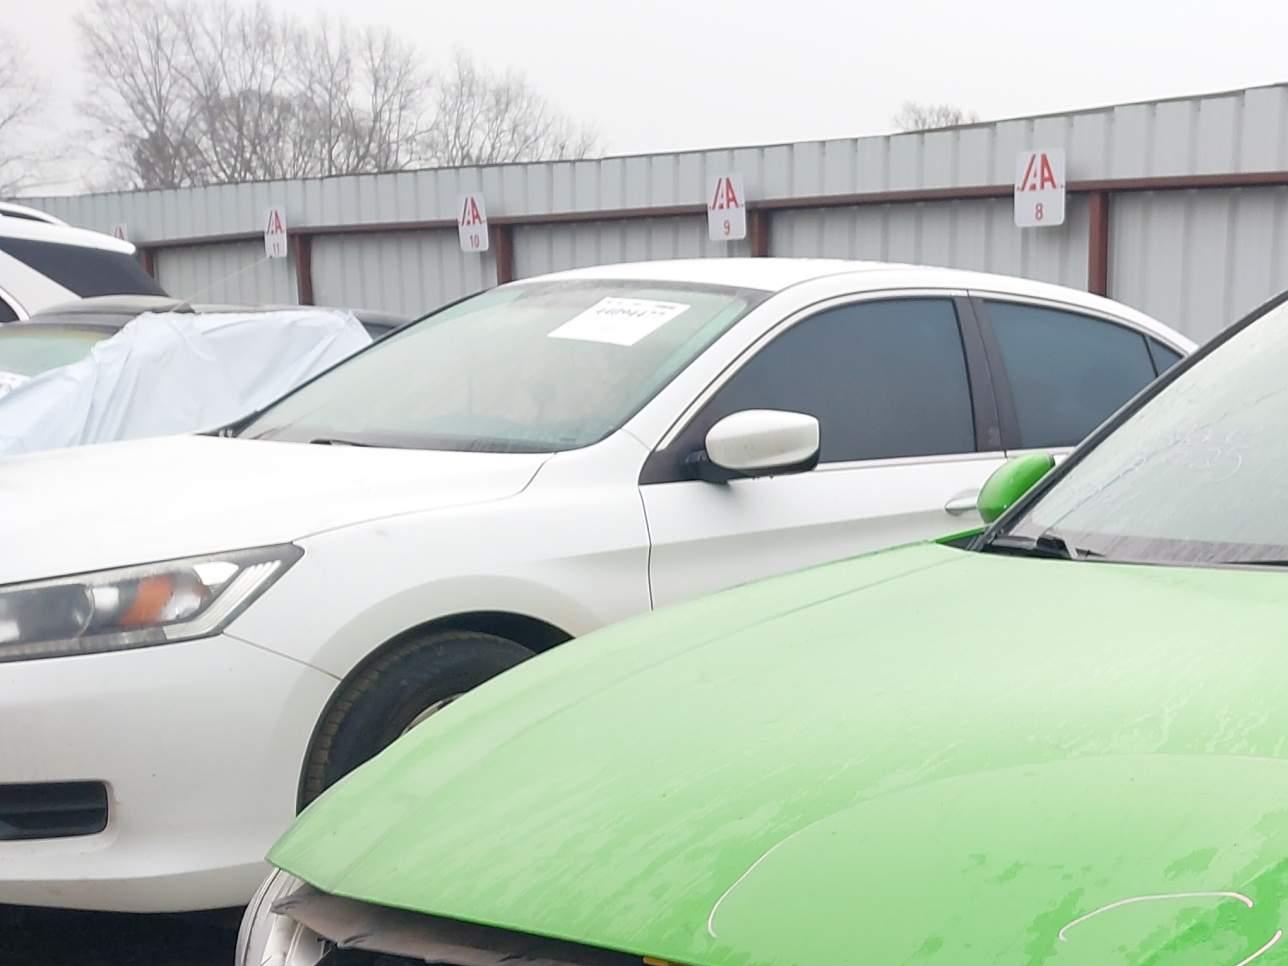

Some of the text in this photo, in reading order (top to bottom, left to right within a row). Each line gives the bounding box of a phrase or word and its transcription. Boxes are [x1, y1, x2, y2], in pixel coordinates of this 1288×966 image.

[1034, 203, 1044, 221] 8
[723, 219, 731, 236] 9
[470, 233, 480, 248] 10
[272, 242, 280, 256] 11
